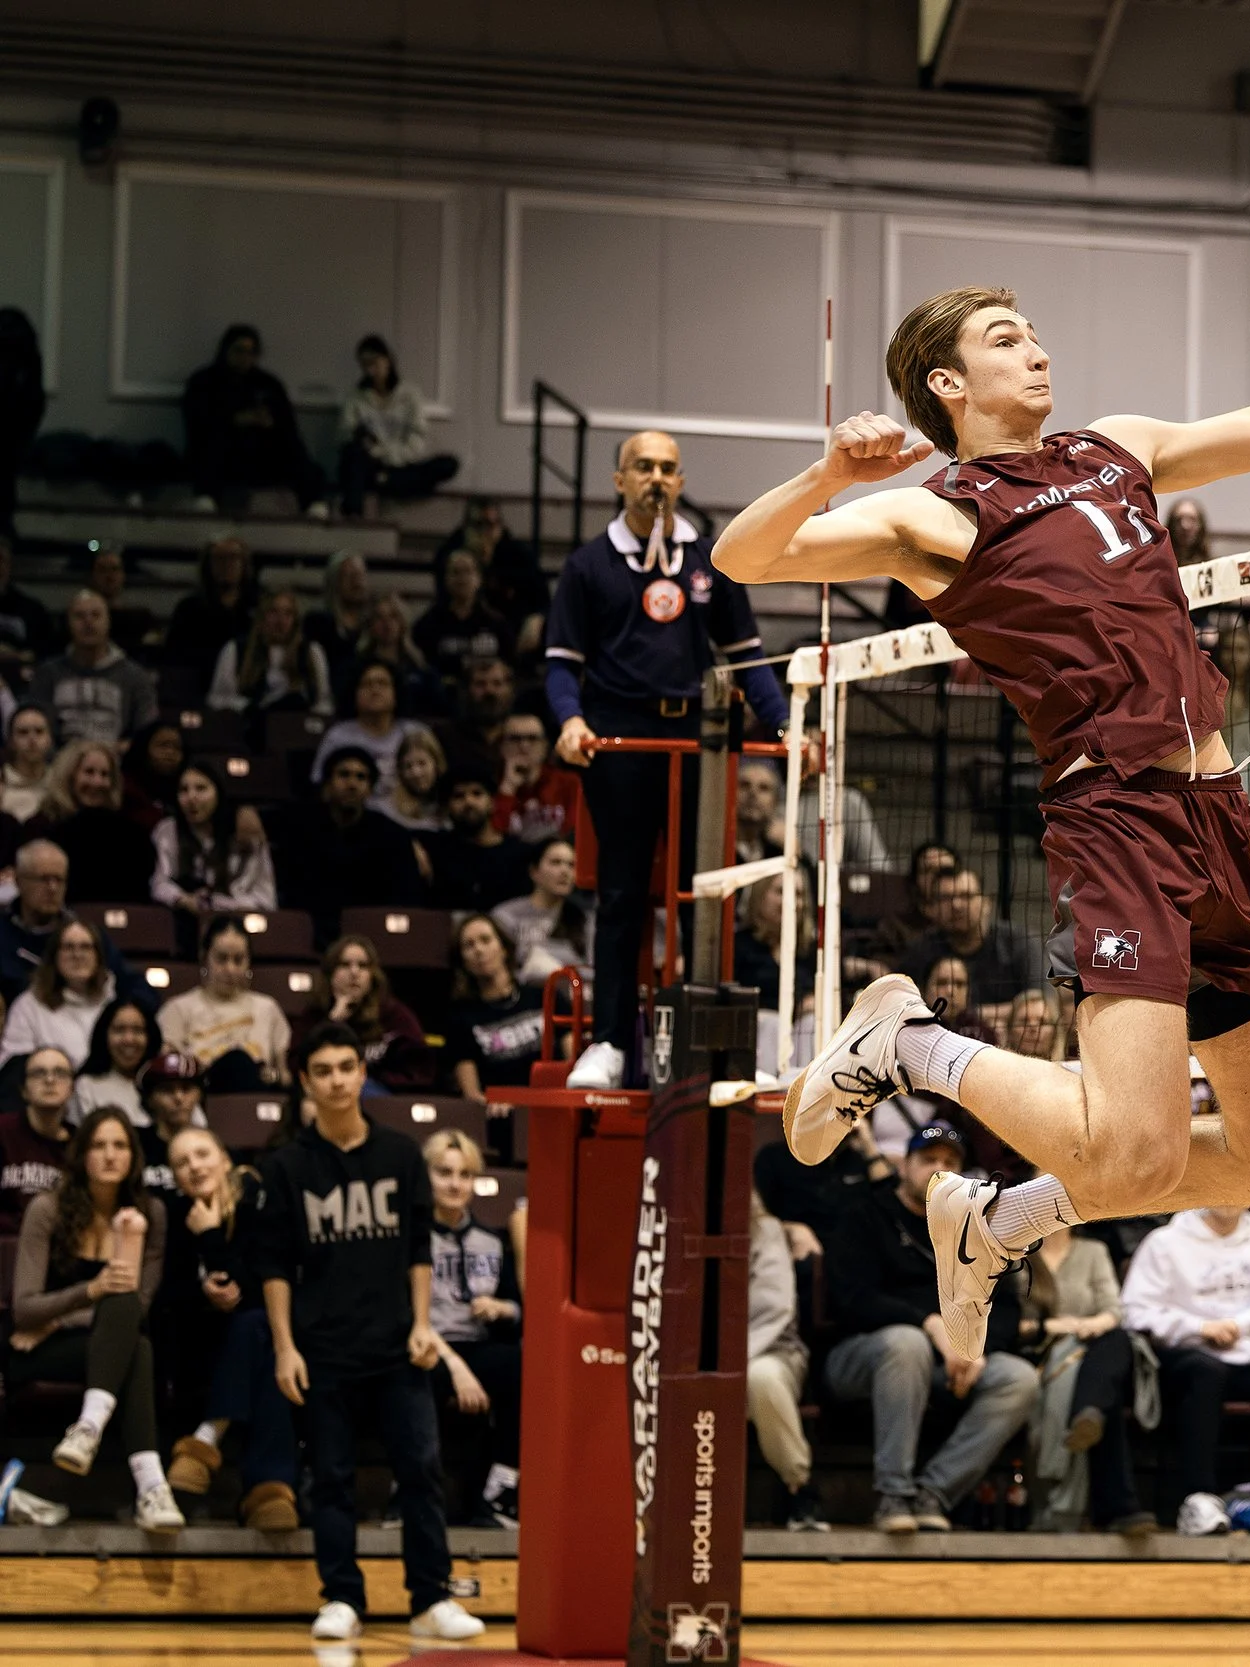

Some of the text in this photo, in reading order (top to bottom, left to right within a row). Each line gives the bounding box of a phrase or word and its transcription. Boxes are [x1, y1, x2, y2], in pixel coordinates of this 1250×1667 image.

[303, 1177, 399, 1236] MAC
[690, 1410, 716, 1585] sports imports
